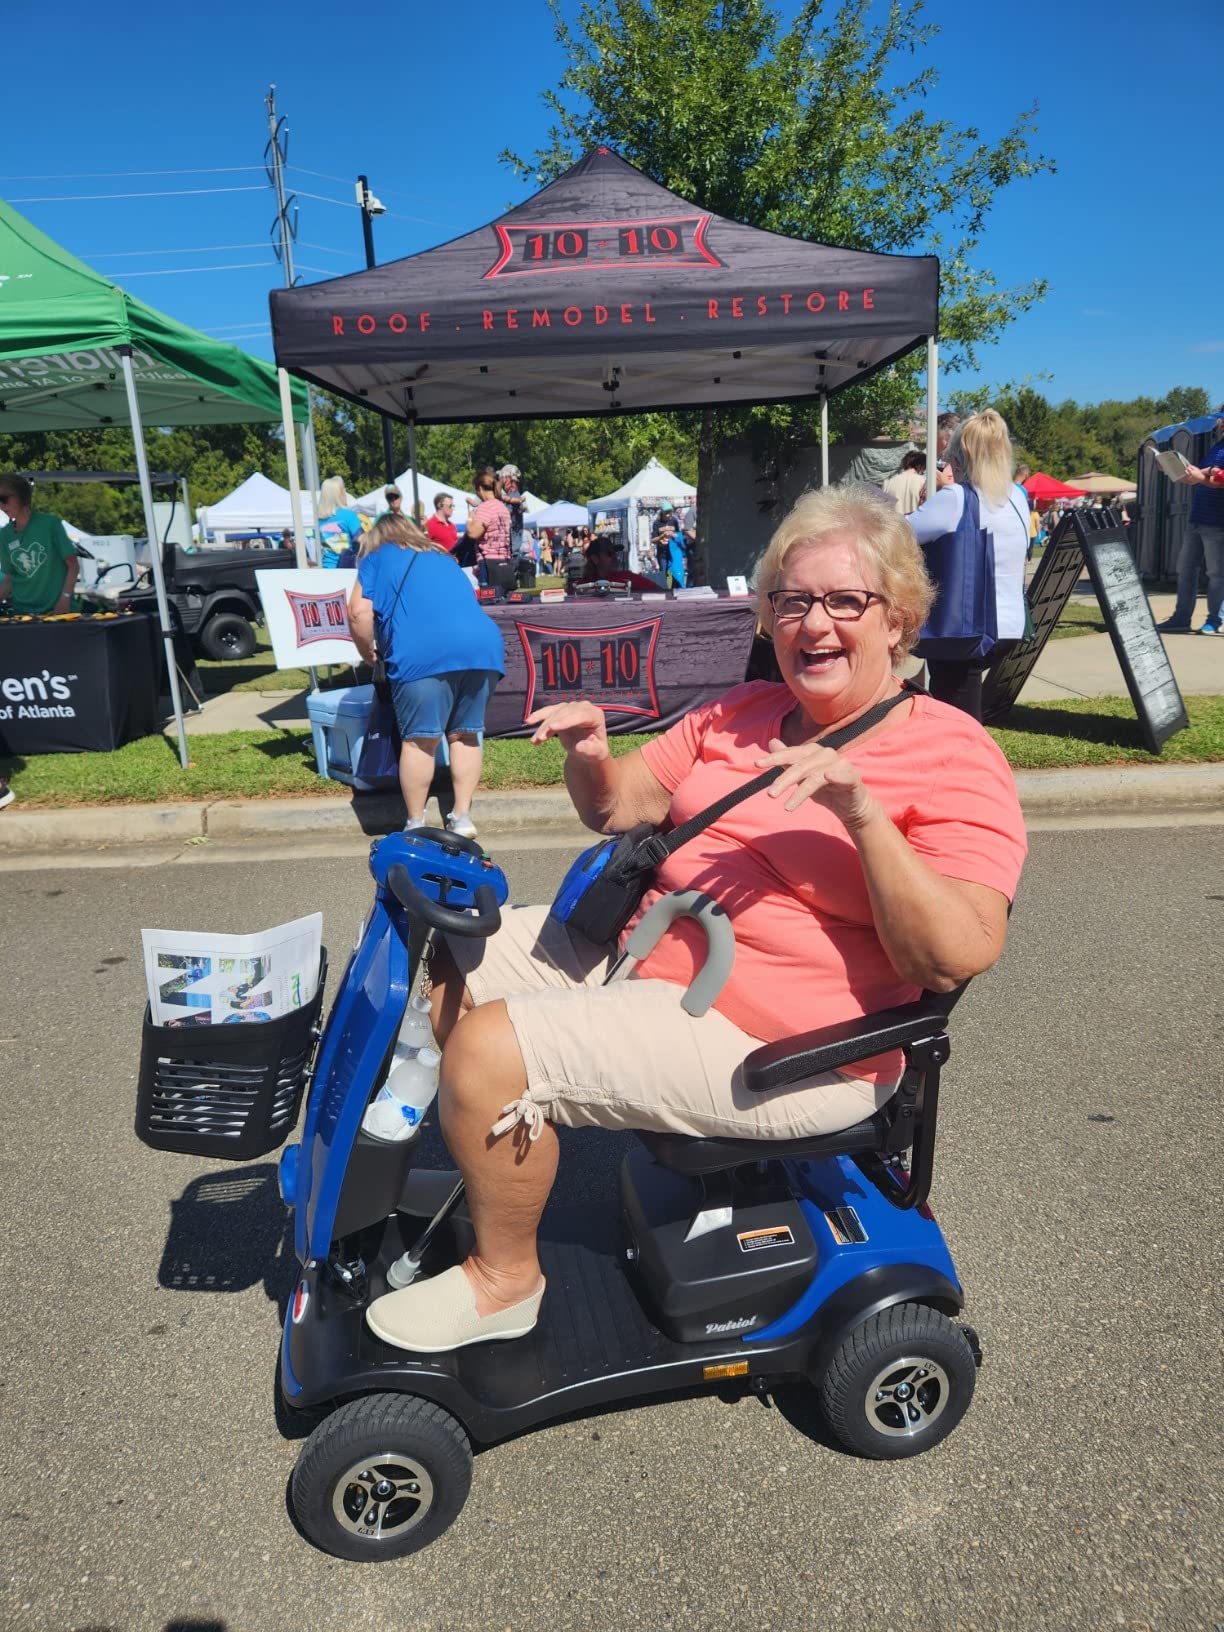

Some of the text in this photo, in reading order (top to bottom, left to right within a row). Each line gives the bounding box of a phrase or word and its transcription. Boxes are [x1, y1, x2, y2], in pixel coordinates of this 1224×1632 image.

[528, 226, 677, 259] 10 10
[333, 288, 877, 336] ROOF REMODEL RESTORE
[542, 640, 637, 686] 10 10
[0, 669, 71, 702] en's
[18, 704, 76, 719] Atlanta
[705, 1315, 756, 1334] Patriot
